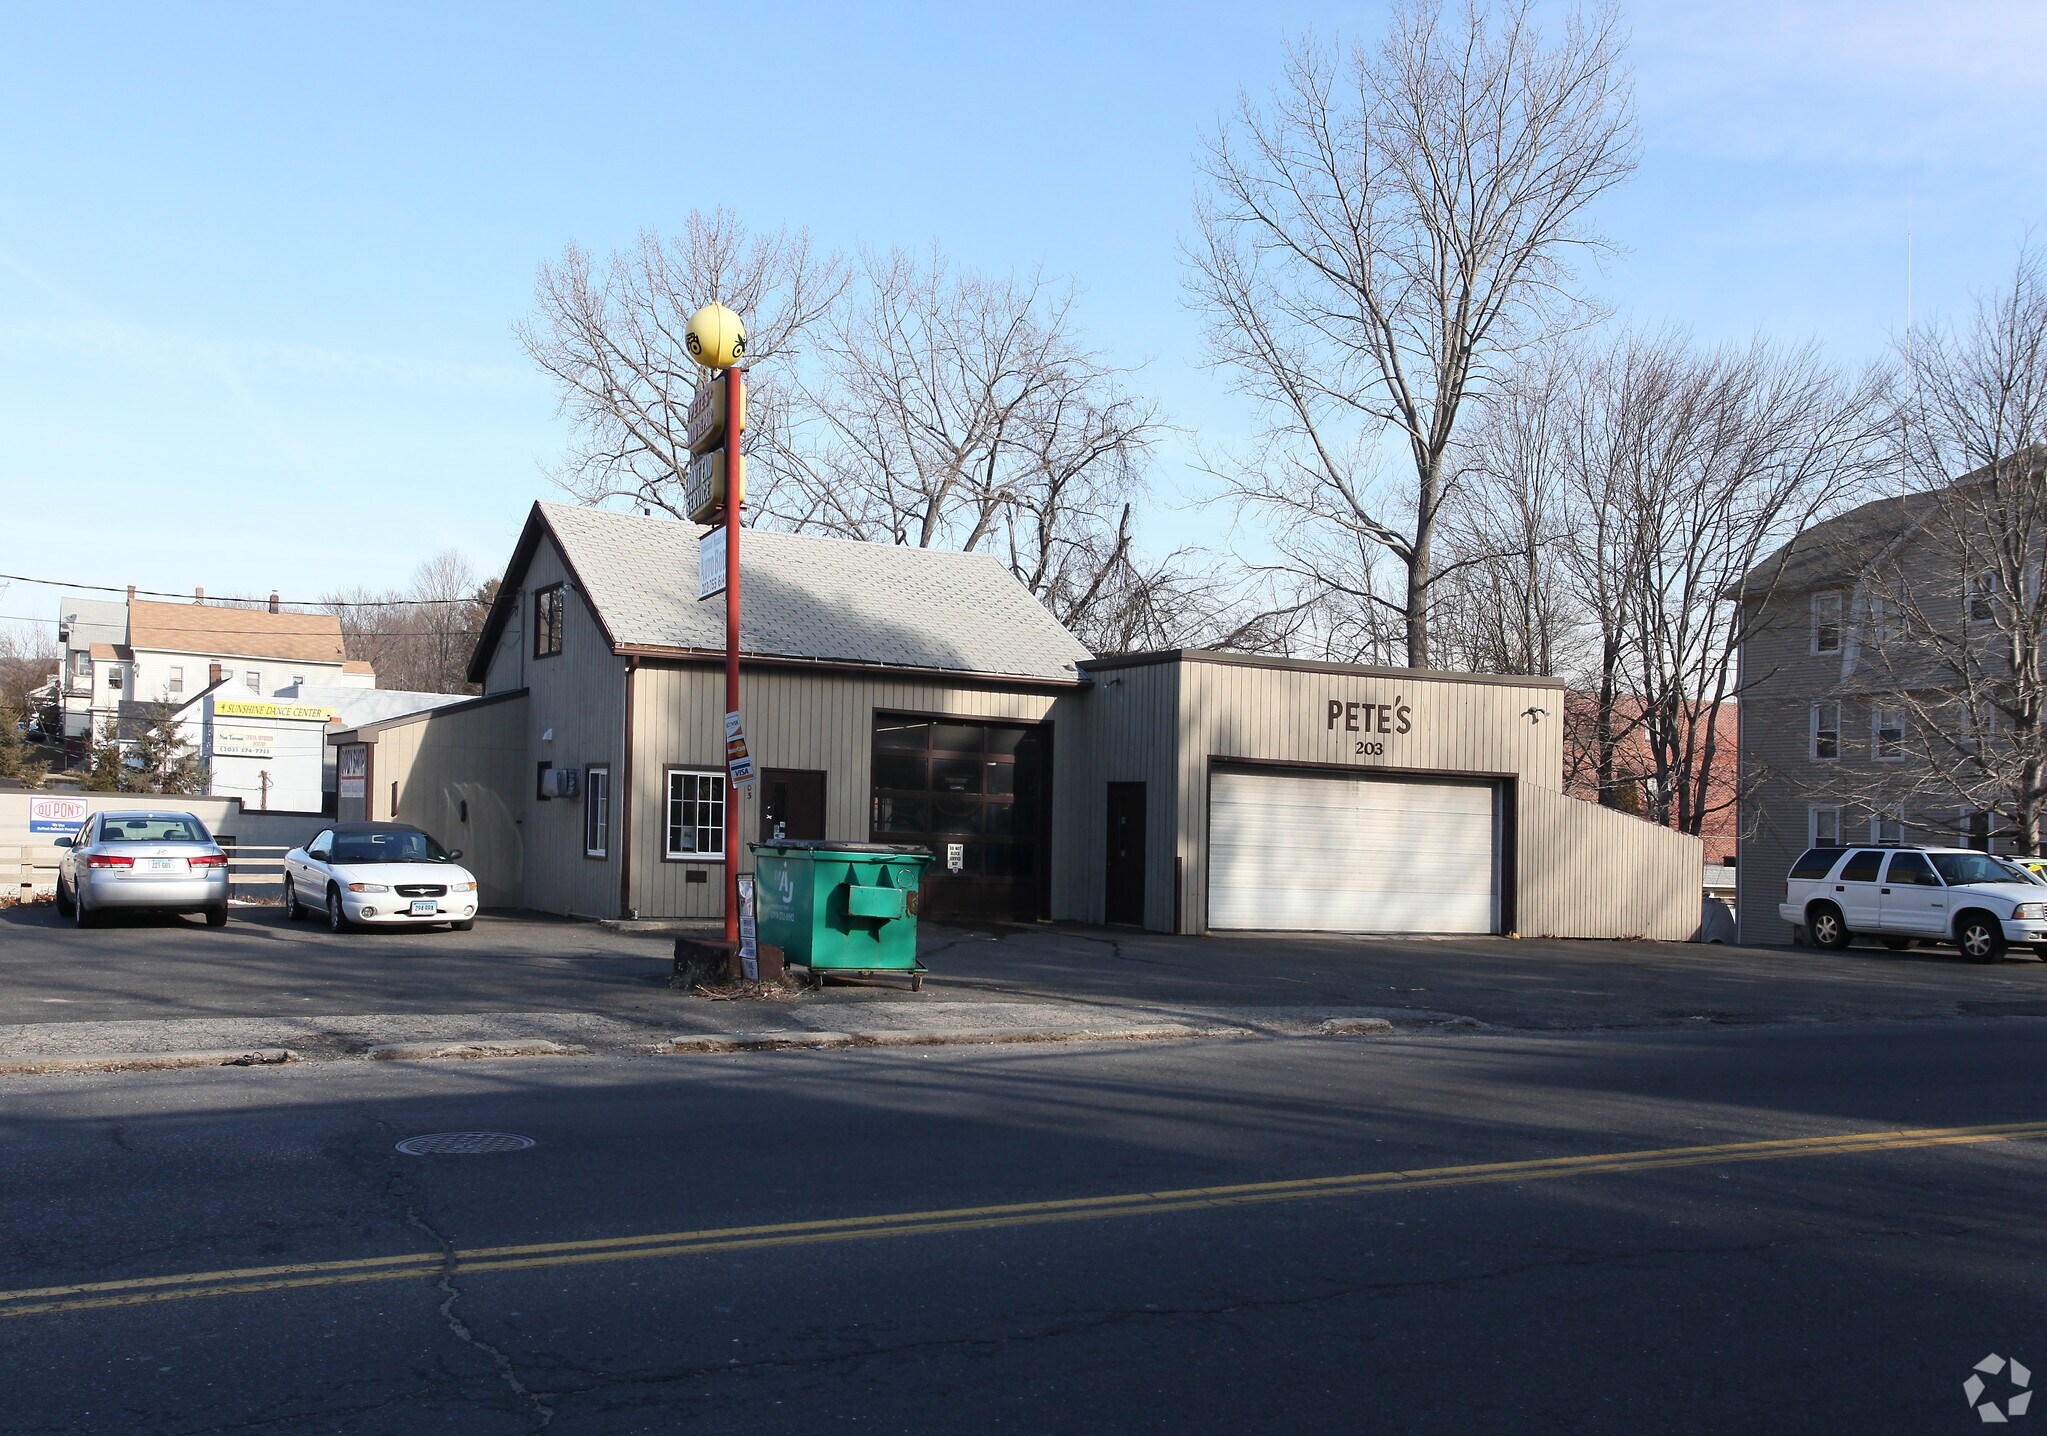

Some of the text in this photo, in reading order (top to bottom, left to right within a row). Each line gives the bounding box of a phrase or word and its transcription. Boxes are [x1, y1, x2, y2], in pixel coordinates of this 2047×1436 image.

[226, 703, 322, 718] SUNSHINE DANCE CENTER
[1328, 695, 1411, 734] PETE'S
[1355, 741, 1383, 755] 203
[735, 768, 749, 777] VISA
